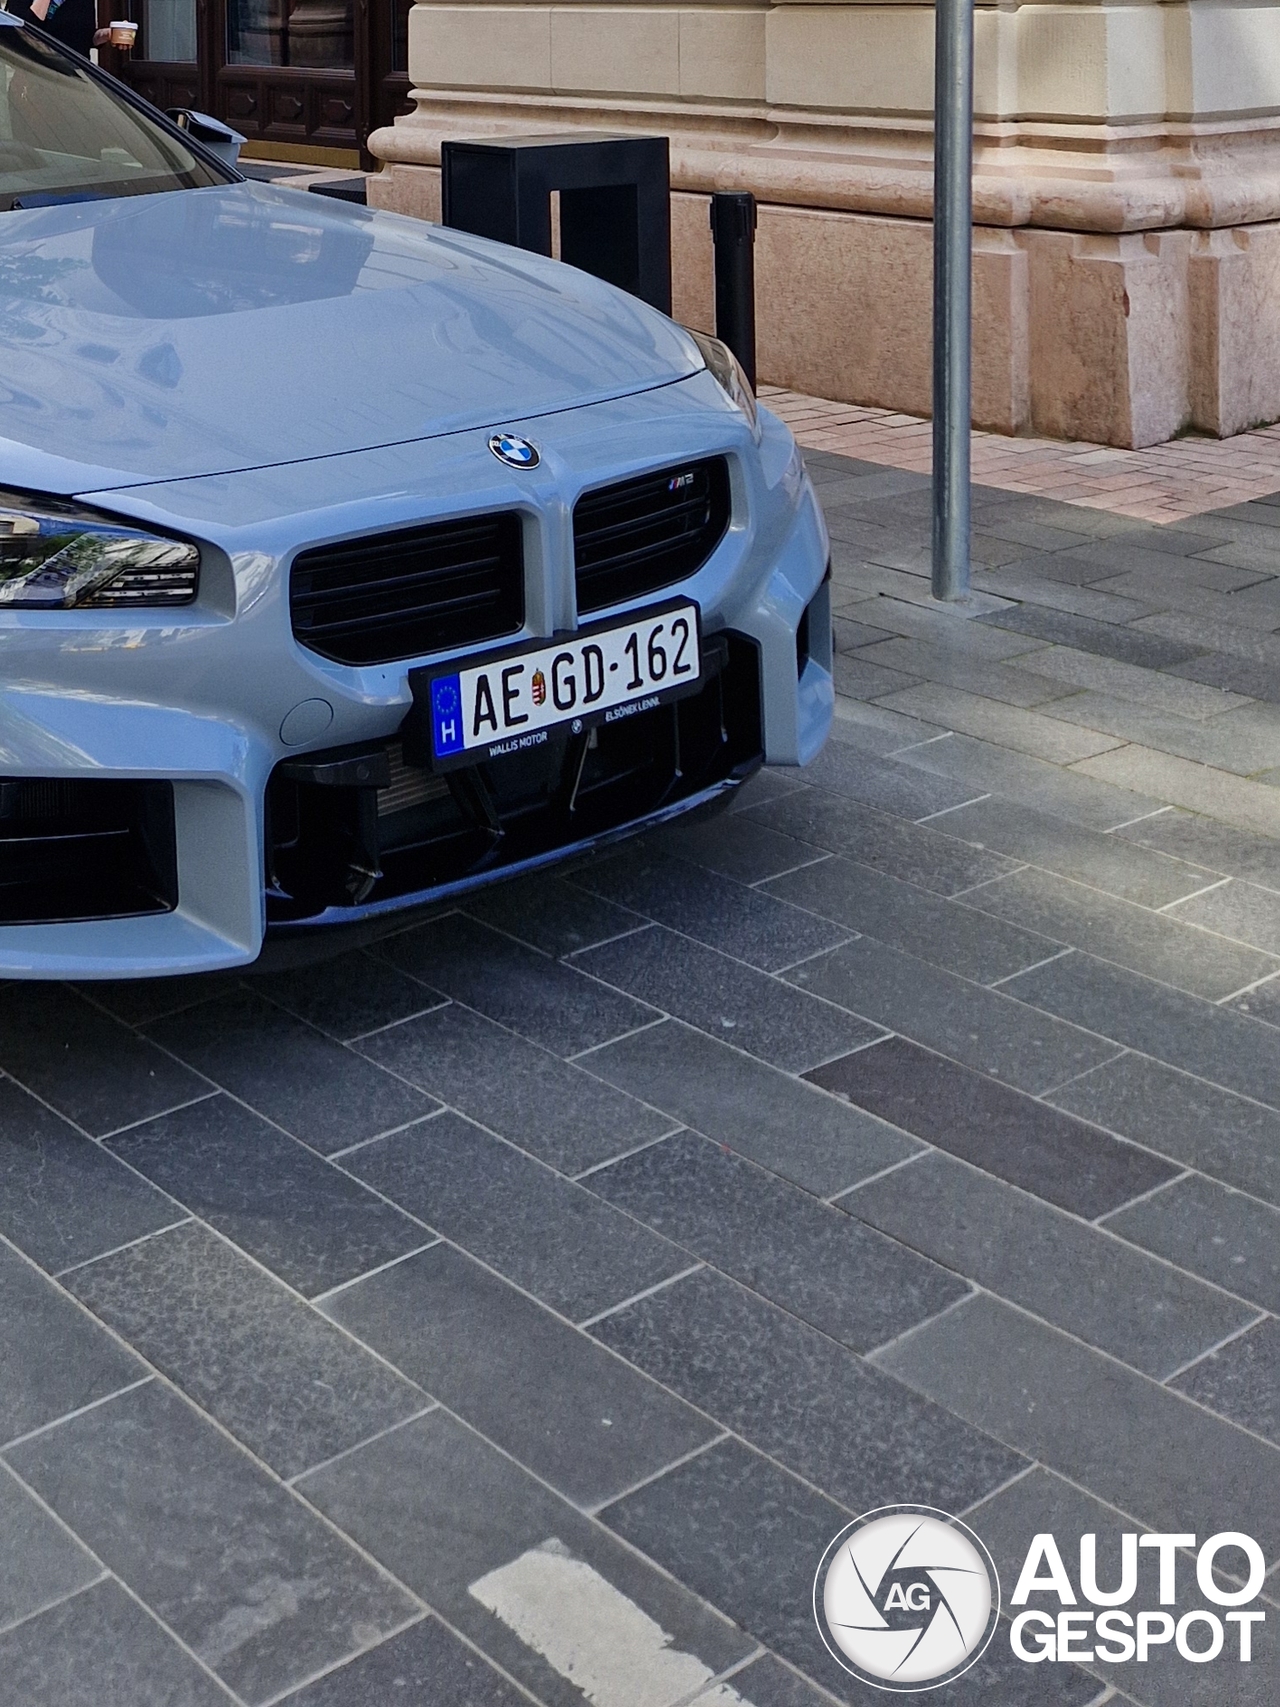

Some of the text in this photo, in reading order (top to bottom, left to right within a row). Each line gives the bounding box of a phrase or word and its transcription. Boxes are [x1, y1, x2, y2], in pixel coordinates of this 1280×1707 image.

[473, 664, 529, 736] AE
[441, 719, 456, 744] H
[489, 731, 548, 757] WALLIS MOTOR
